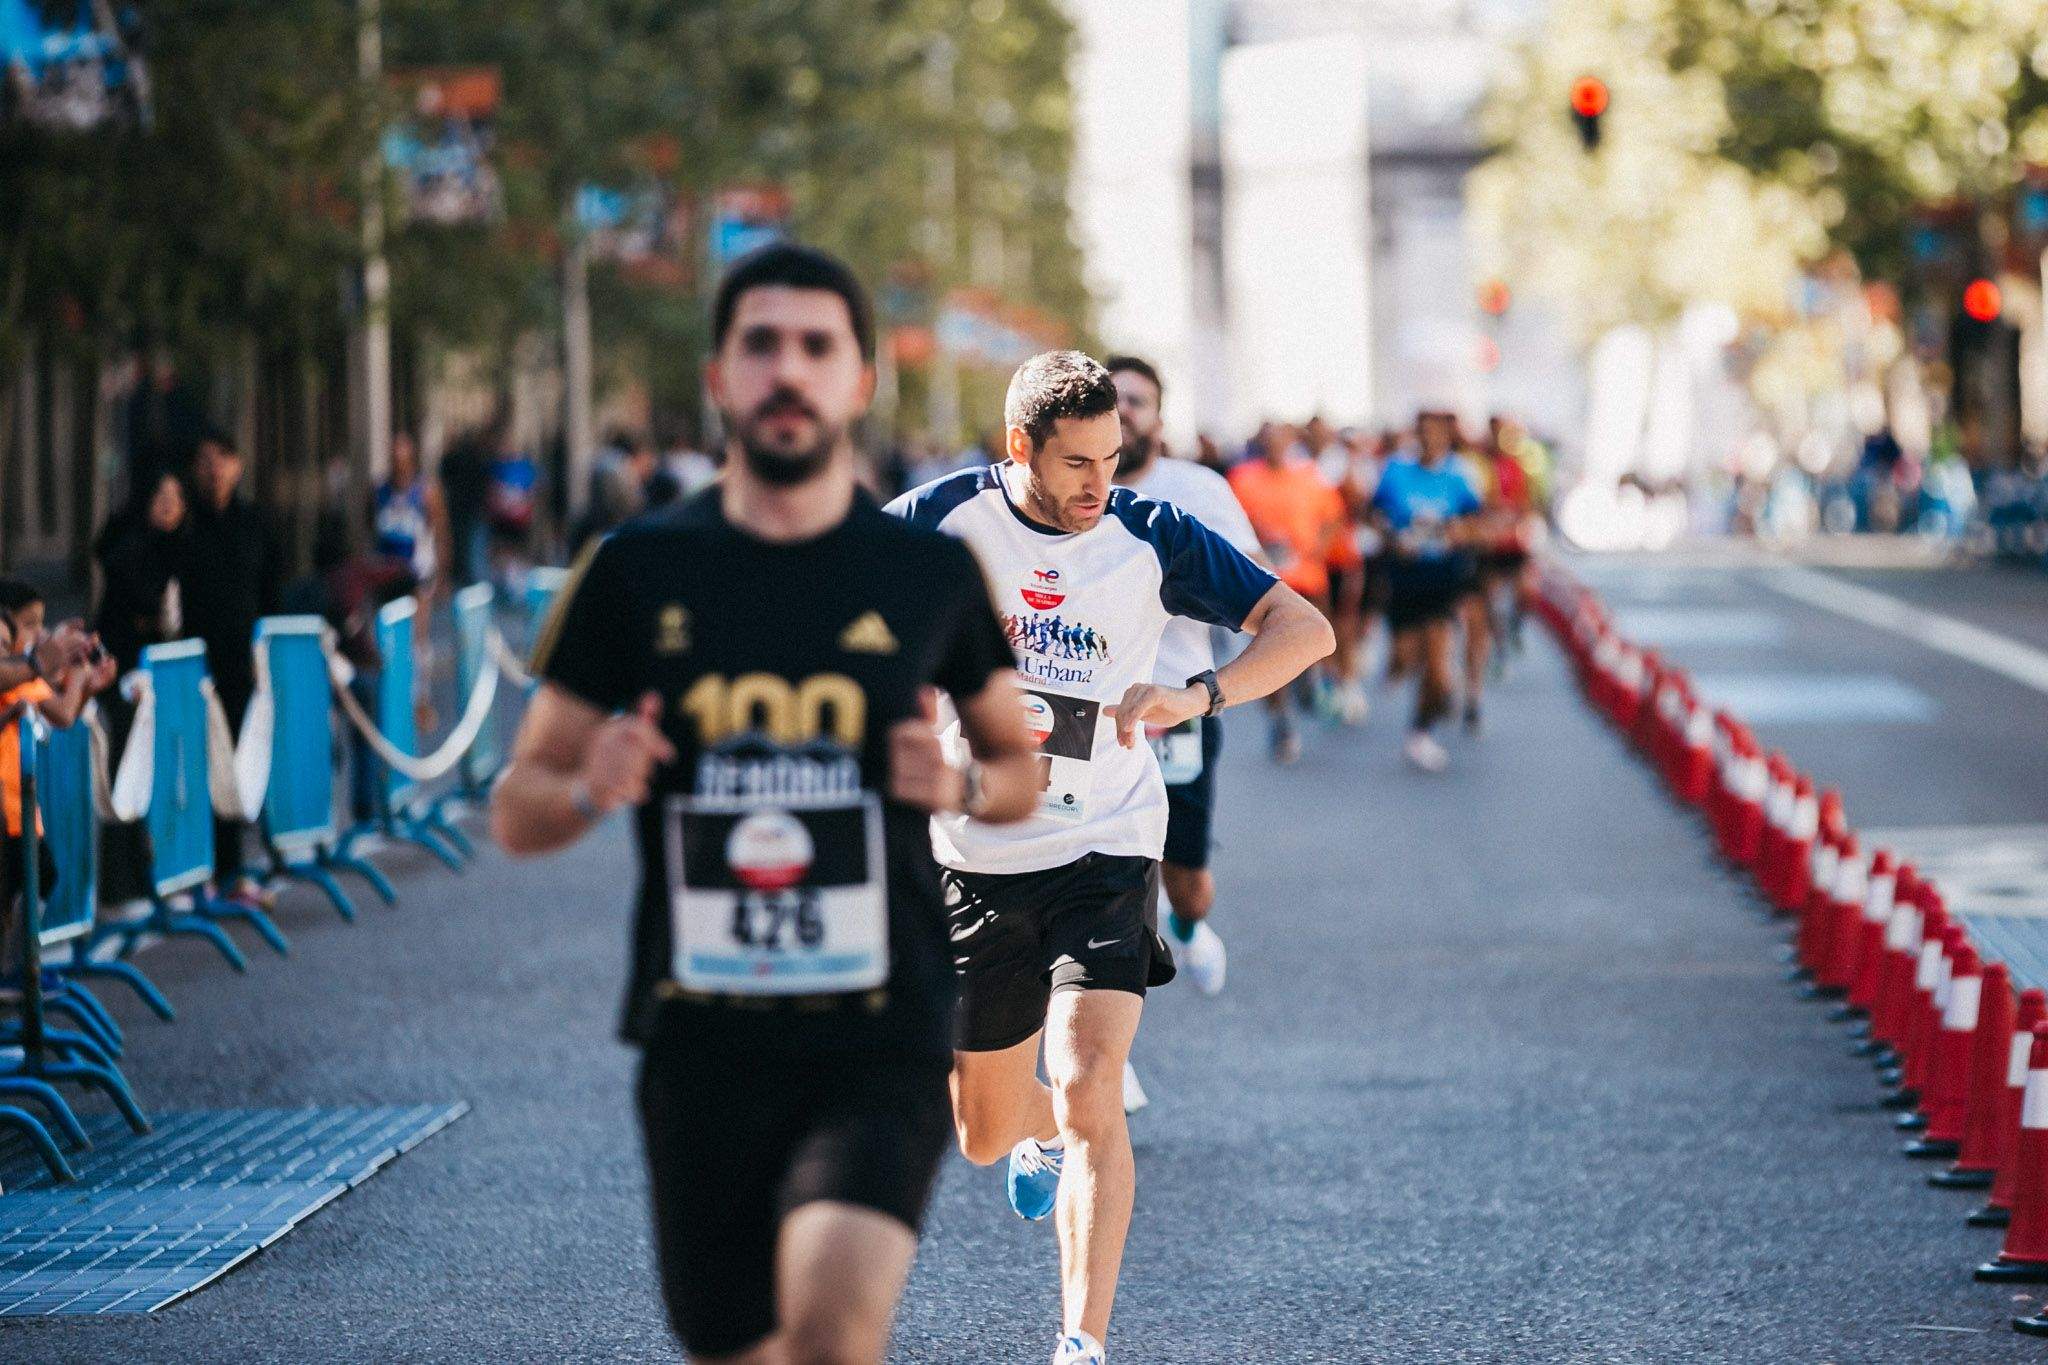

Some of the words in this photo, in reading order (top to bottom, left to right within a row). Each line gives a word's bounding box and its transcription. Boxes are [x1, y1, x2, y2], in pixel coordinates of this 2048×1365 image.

[1016, 672, 1047, 685] Madrid
[1024, 656, 1092, 683] Urbana
[683, 673, 866, 748] 100
